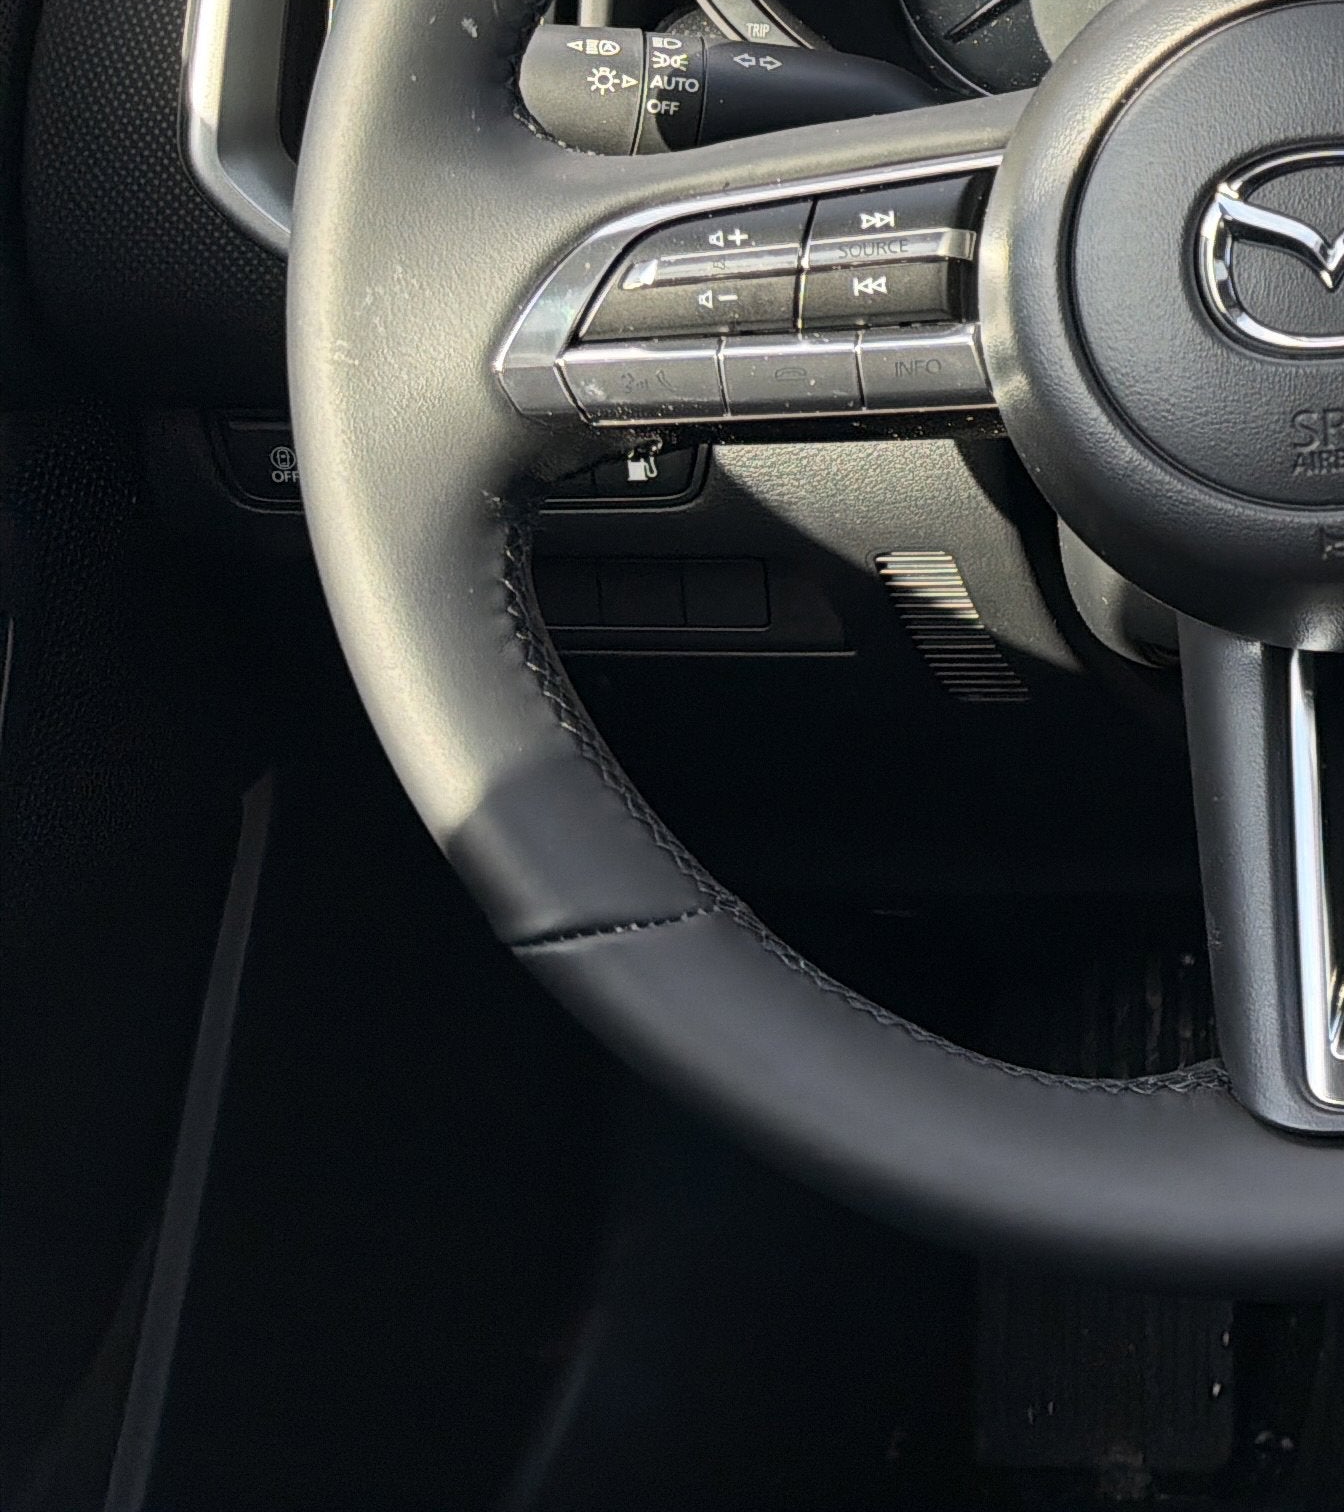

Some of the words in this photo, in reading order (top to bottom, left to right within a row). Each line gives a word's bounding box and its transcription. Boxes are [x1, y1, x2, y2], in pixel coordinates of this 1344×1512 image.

[746, 22, 771, 38] TRIP
[650, 75, 699, 93] AUTO
[647, 98, 680, 116] OFF
[838, 239, 909, 259] SOURCE
[894, 359, 942, 378] INFO
[271, 470, 301, 483] OFF
